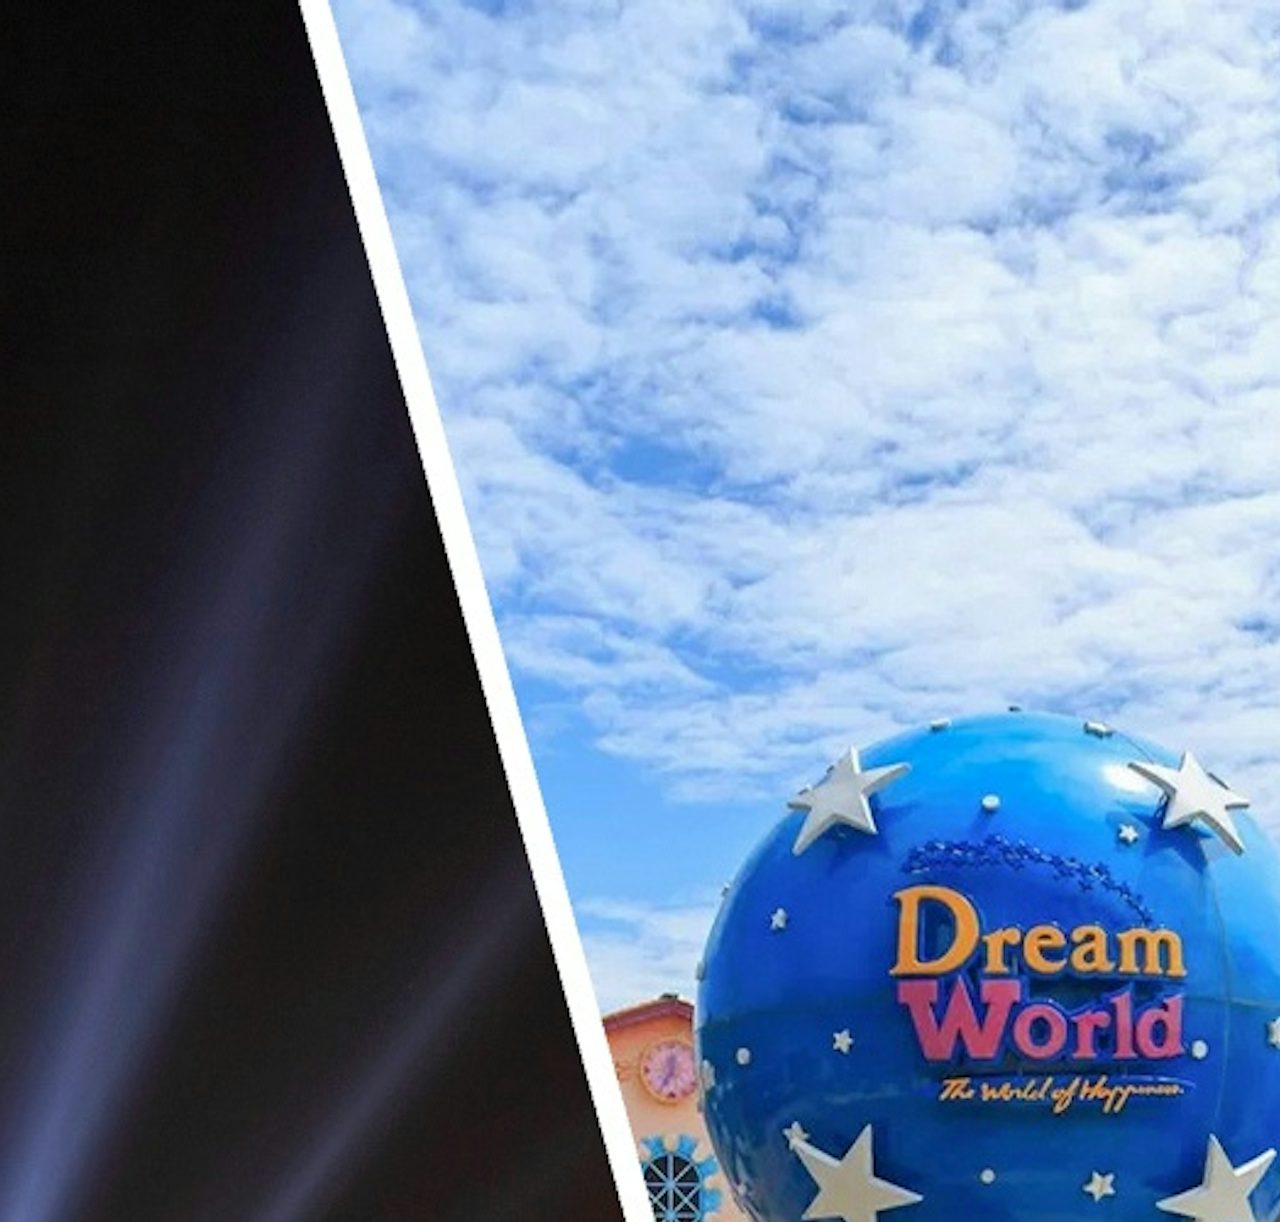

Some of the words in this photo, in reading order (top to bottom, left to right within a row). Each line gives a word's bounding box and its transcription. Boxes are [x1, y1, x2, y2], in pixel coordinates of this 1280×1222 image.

[889, 884, 1187, 977] Dream
[898, 976, 1185, 1060] World
[939, 1077, 974, 1101] The
[981, 1077, 1053, 1101] World
[1051, 1077, 1081, 1114] of
